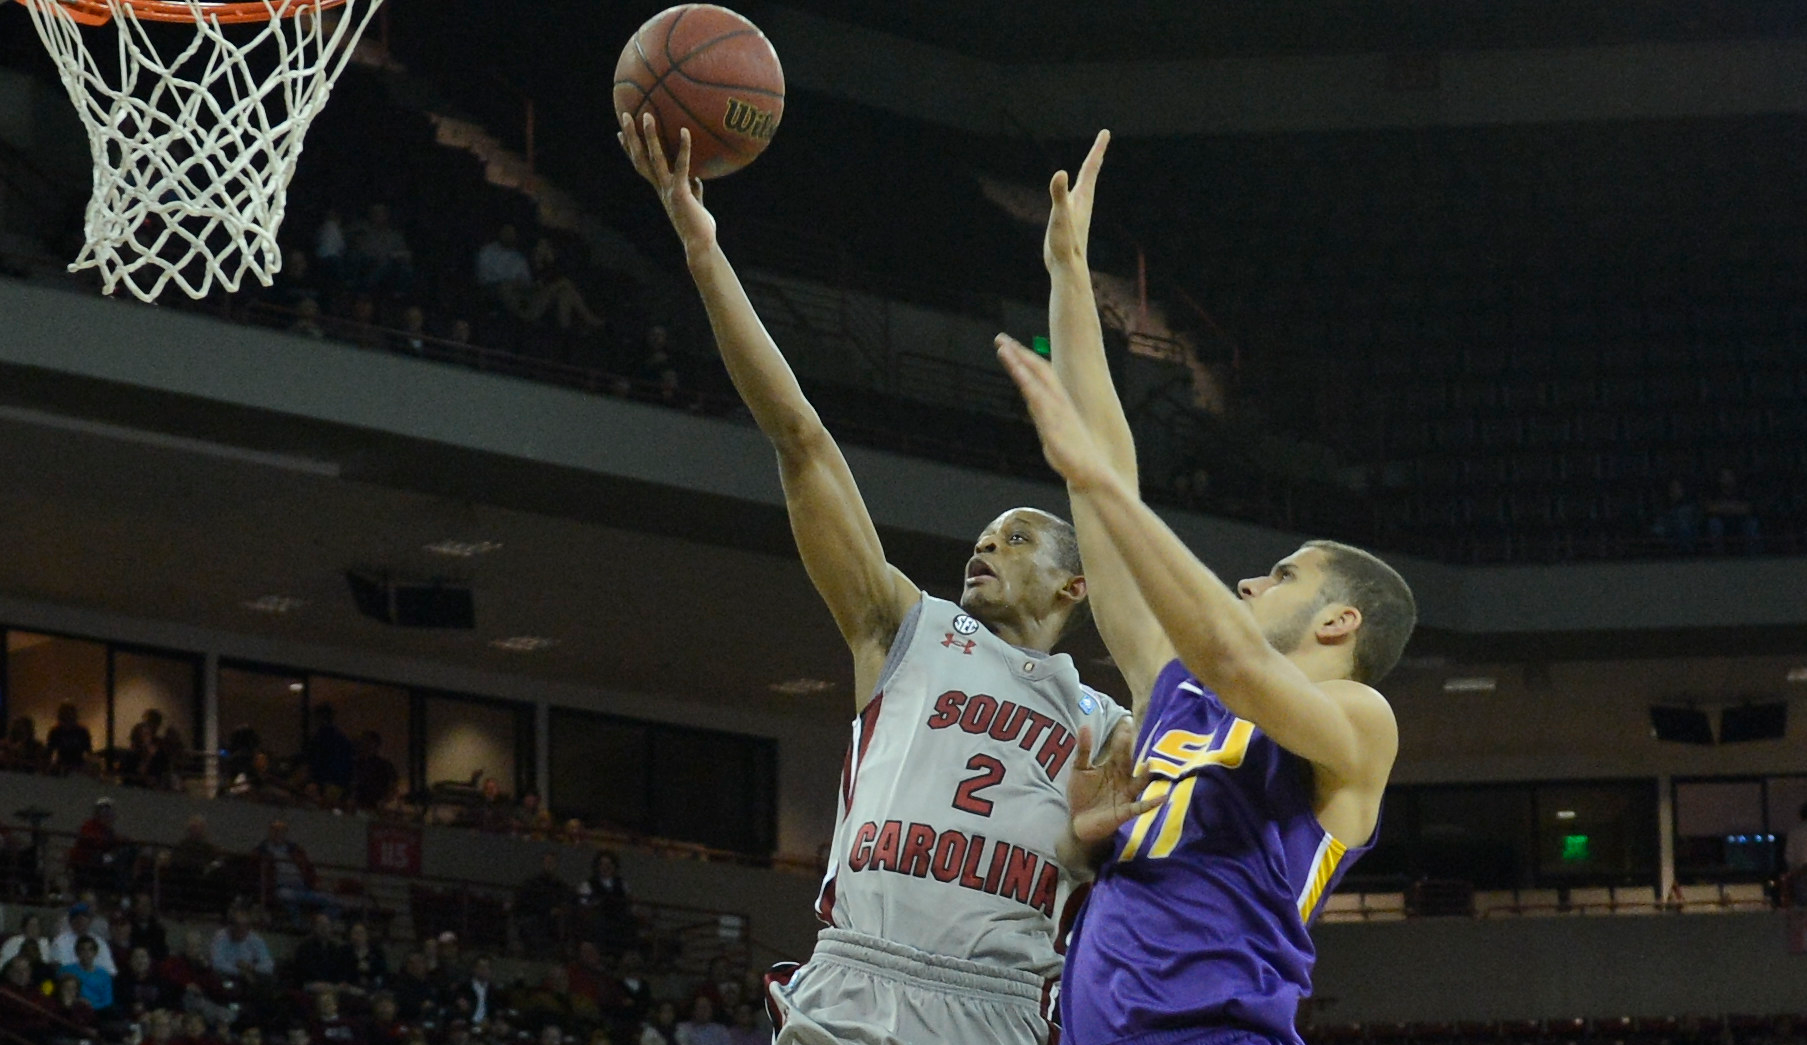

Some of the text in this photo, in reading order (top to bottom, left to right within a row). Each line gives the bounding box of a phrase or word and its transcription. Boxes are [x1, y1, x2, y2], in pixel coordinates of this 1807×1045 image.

[954, 615, 979, 634] SEC
[927, 690, 1077, 782] SOUTH
[951, 753, 1006, 818] 2
[848, 820, 1058, 919] CAROLINA
